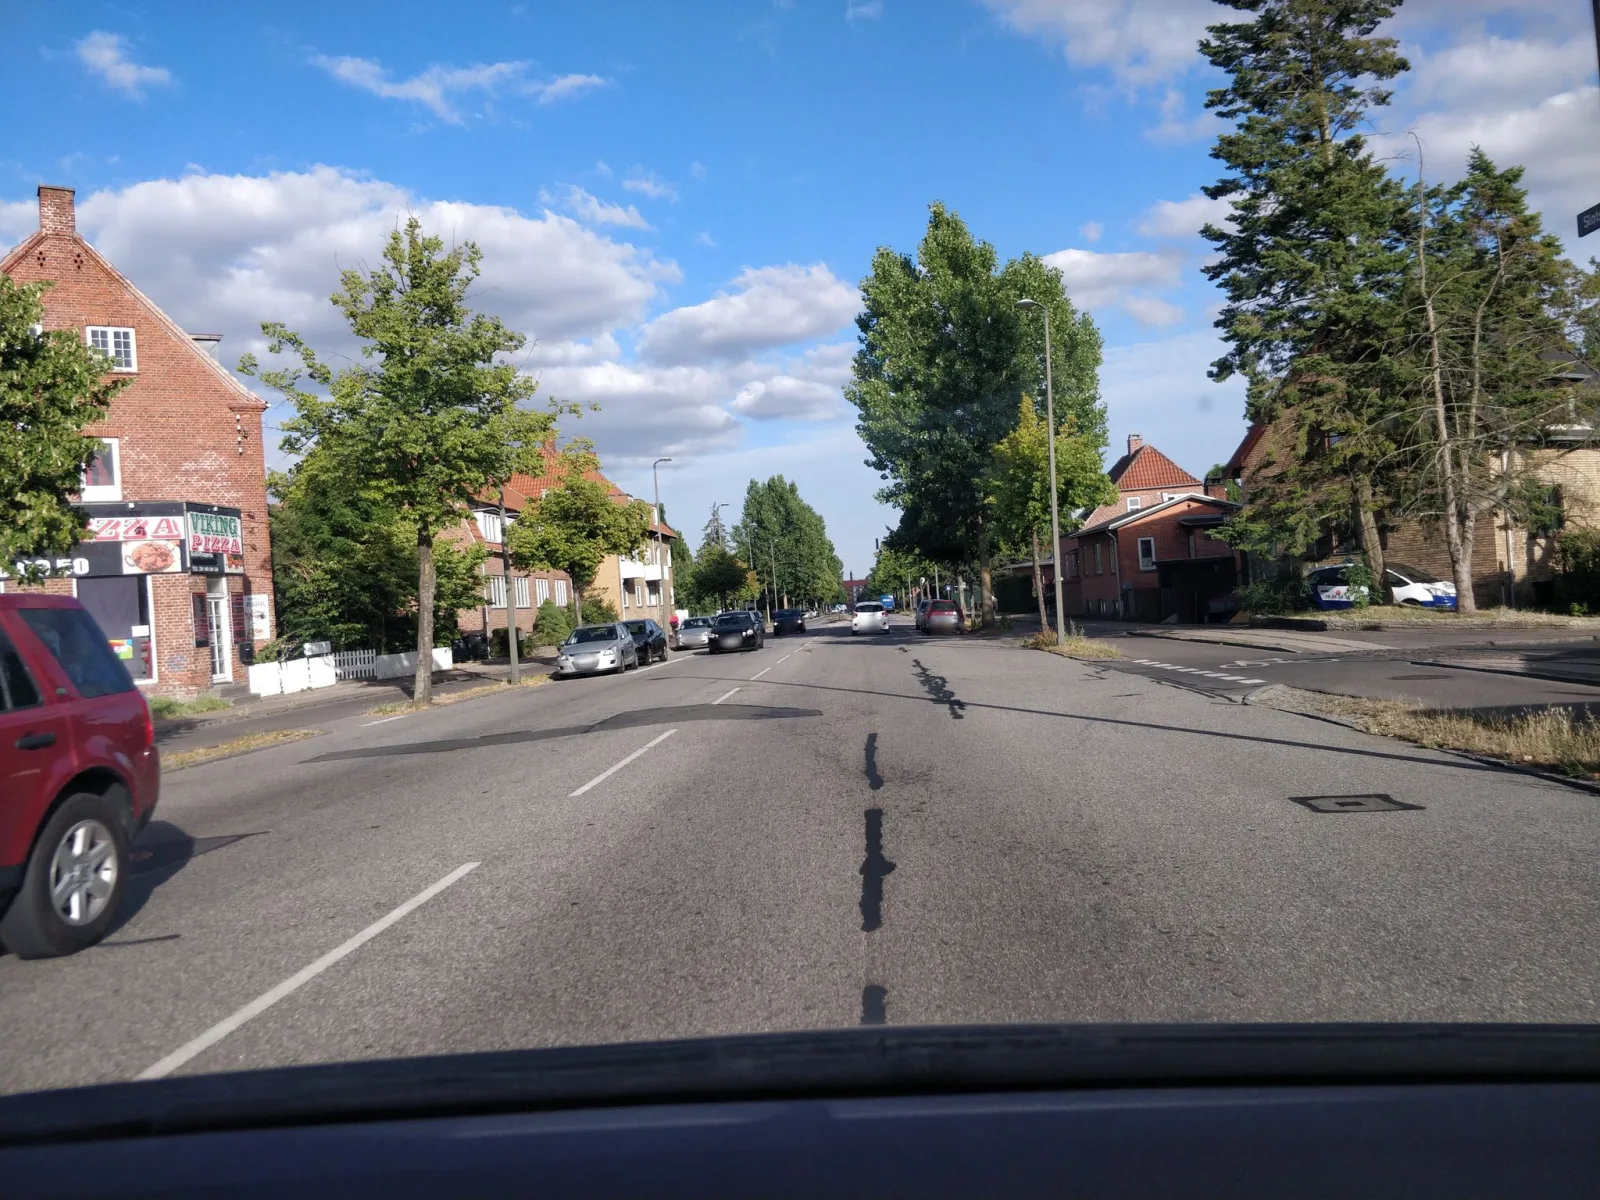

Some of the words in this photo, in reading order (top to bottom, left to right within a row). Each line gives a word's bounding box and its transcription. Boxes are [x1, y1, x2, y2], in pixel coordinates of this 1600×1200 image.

[1583, 210, 1600, 228] Slot
[190, 512, 238, 537] VIKING
[191, 535, 241, 554] PIZZA
